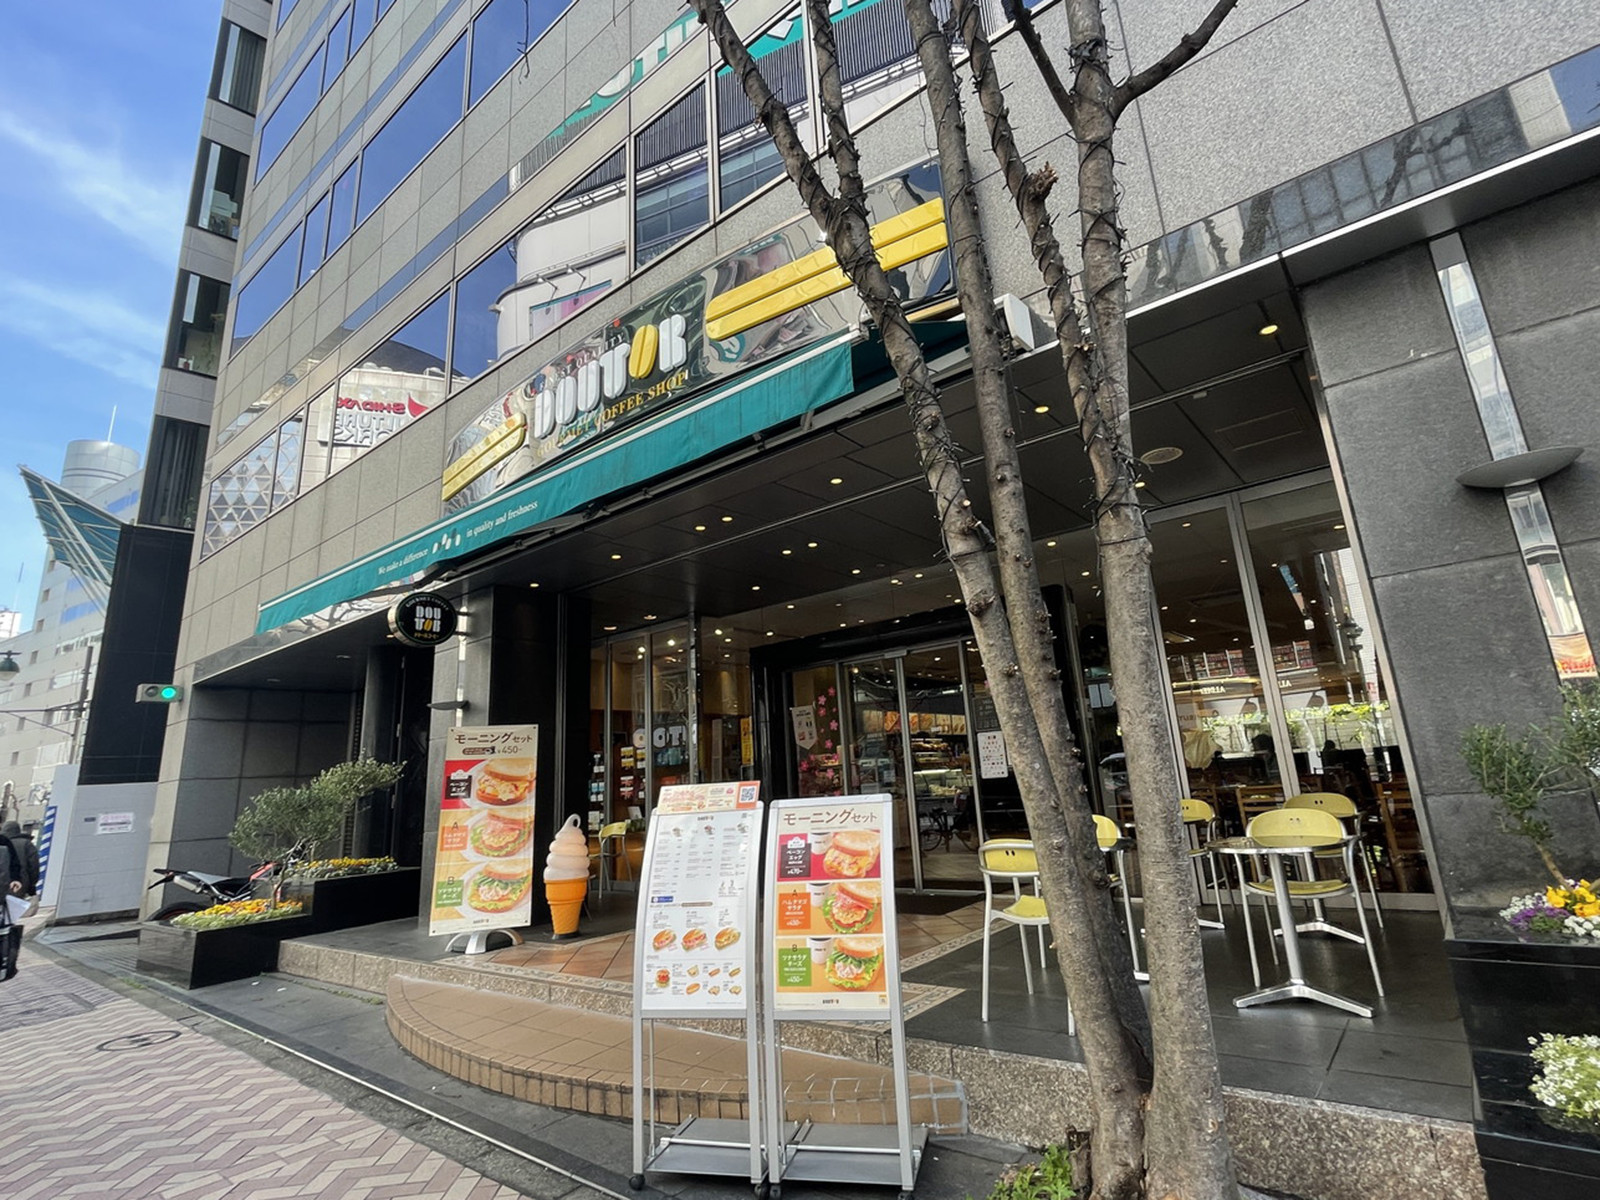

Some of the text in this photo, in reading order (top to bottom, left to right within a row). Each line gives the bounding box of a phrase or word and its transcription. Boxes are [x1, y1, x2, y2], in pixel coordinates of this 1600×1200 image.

[534, 313, 687, 440] DOUTOR
[593, 392, 646, 427] COFFEE
[647, 373, 687, 401] SHOP
[466, 529, 473, 537] in
[473, 520, 495, 536] quality
[495, 513, 507, 526] and
[507, 501, 539, 520] freshness
[455, 732, 533, 744] モーニングセット
[783, 808, 878, 826] モーニングセット
[451, 821, 459, 830] A
[447, 876, 455, 886] B
[791, 889, 798, 897] A
[792, 944, 798, 952] B
